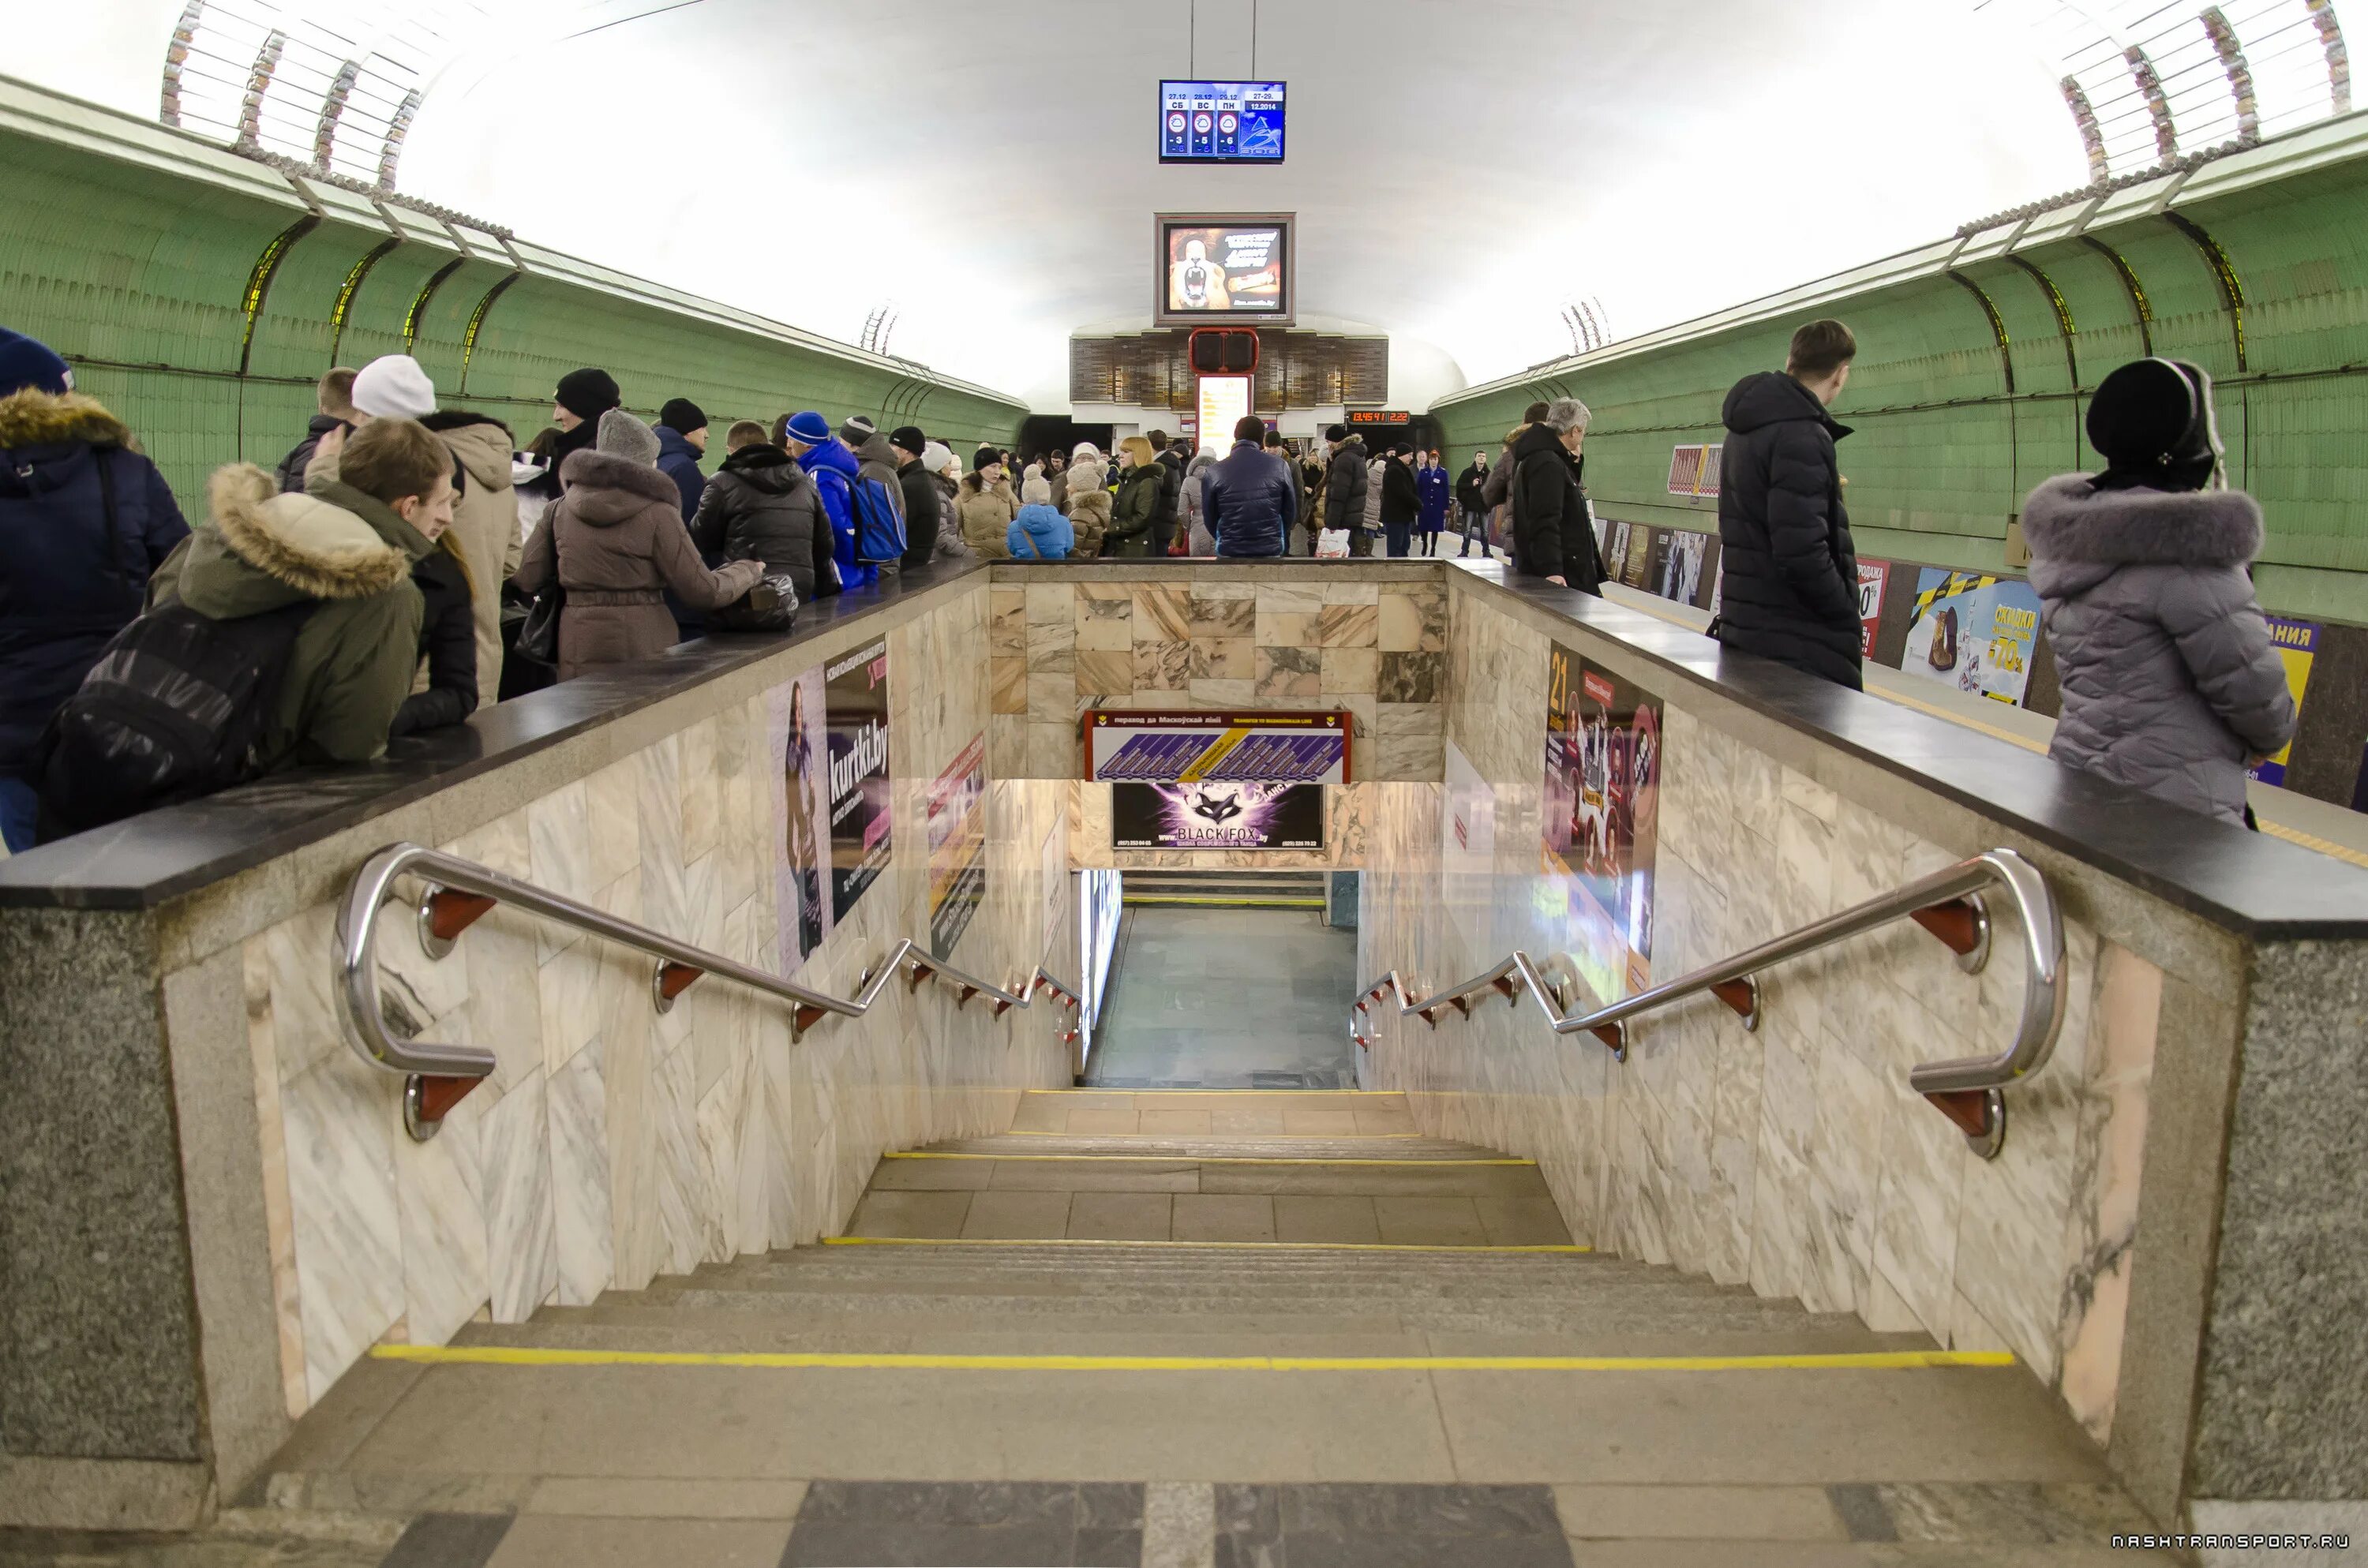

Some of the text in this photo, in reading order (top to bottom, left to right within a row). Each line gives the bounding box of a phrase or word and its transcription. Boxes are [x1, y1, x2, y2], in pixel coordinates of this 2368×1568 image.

[1390, 413, 1407, 421] 2.22
[1550, 651, 1568, 715] 21
[830, 717, 888, 805] kurtki.by
[1178, 828, 1224, 840] BLACK
[1229, 828, 1256, 840] FOX
